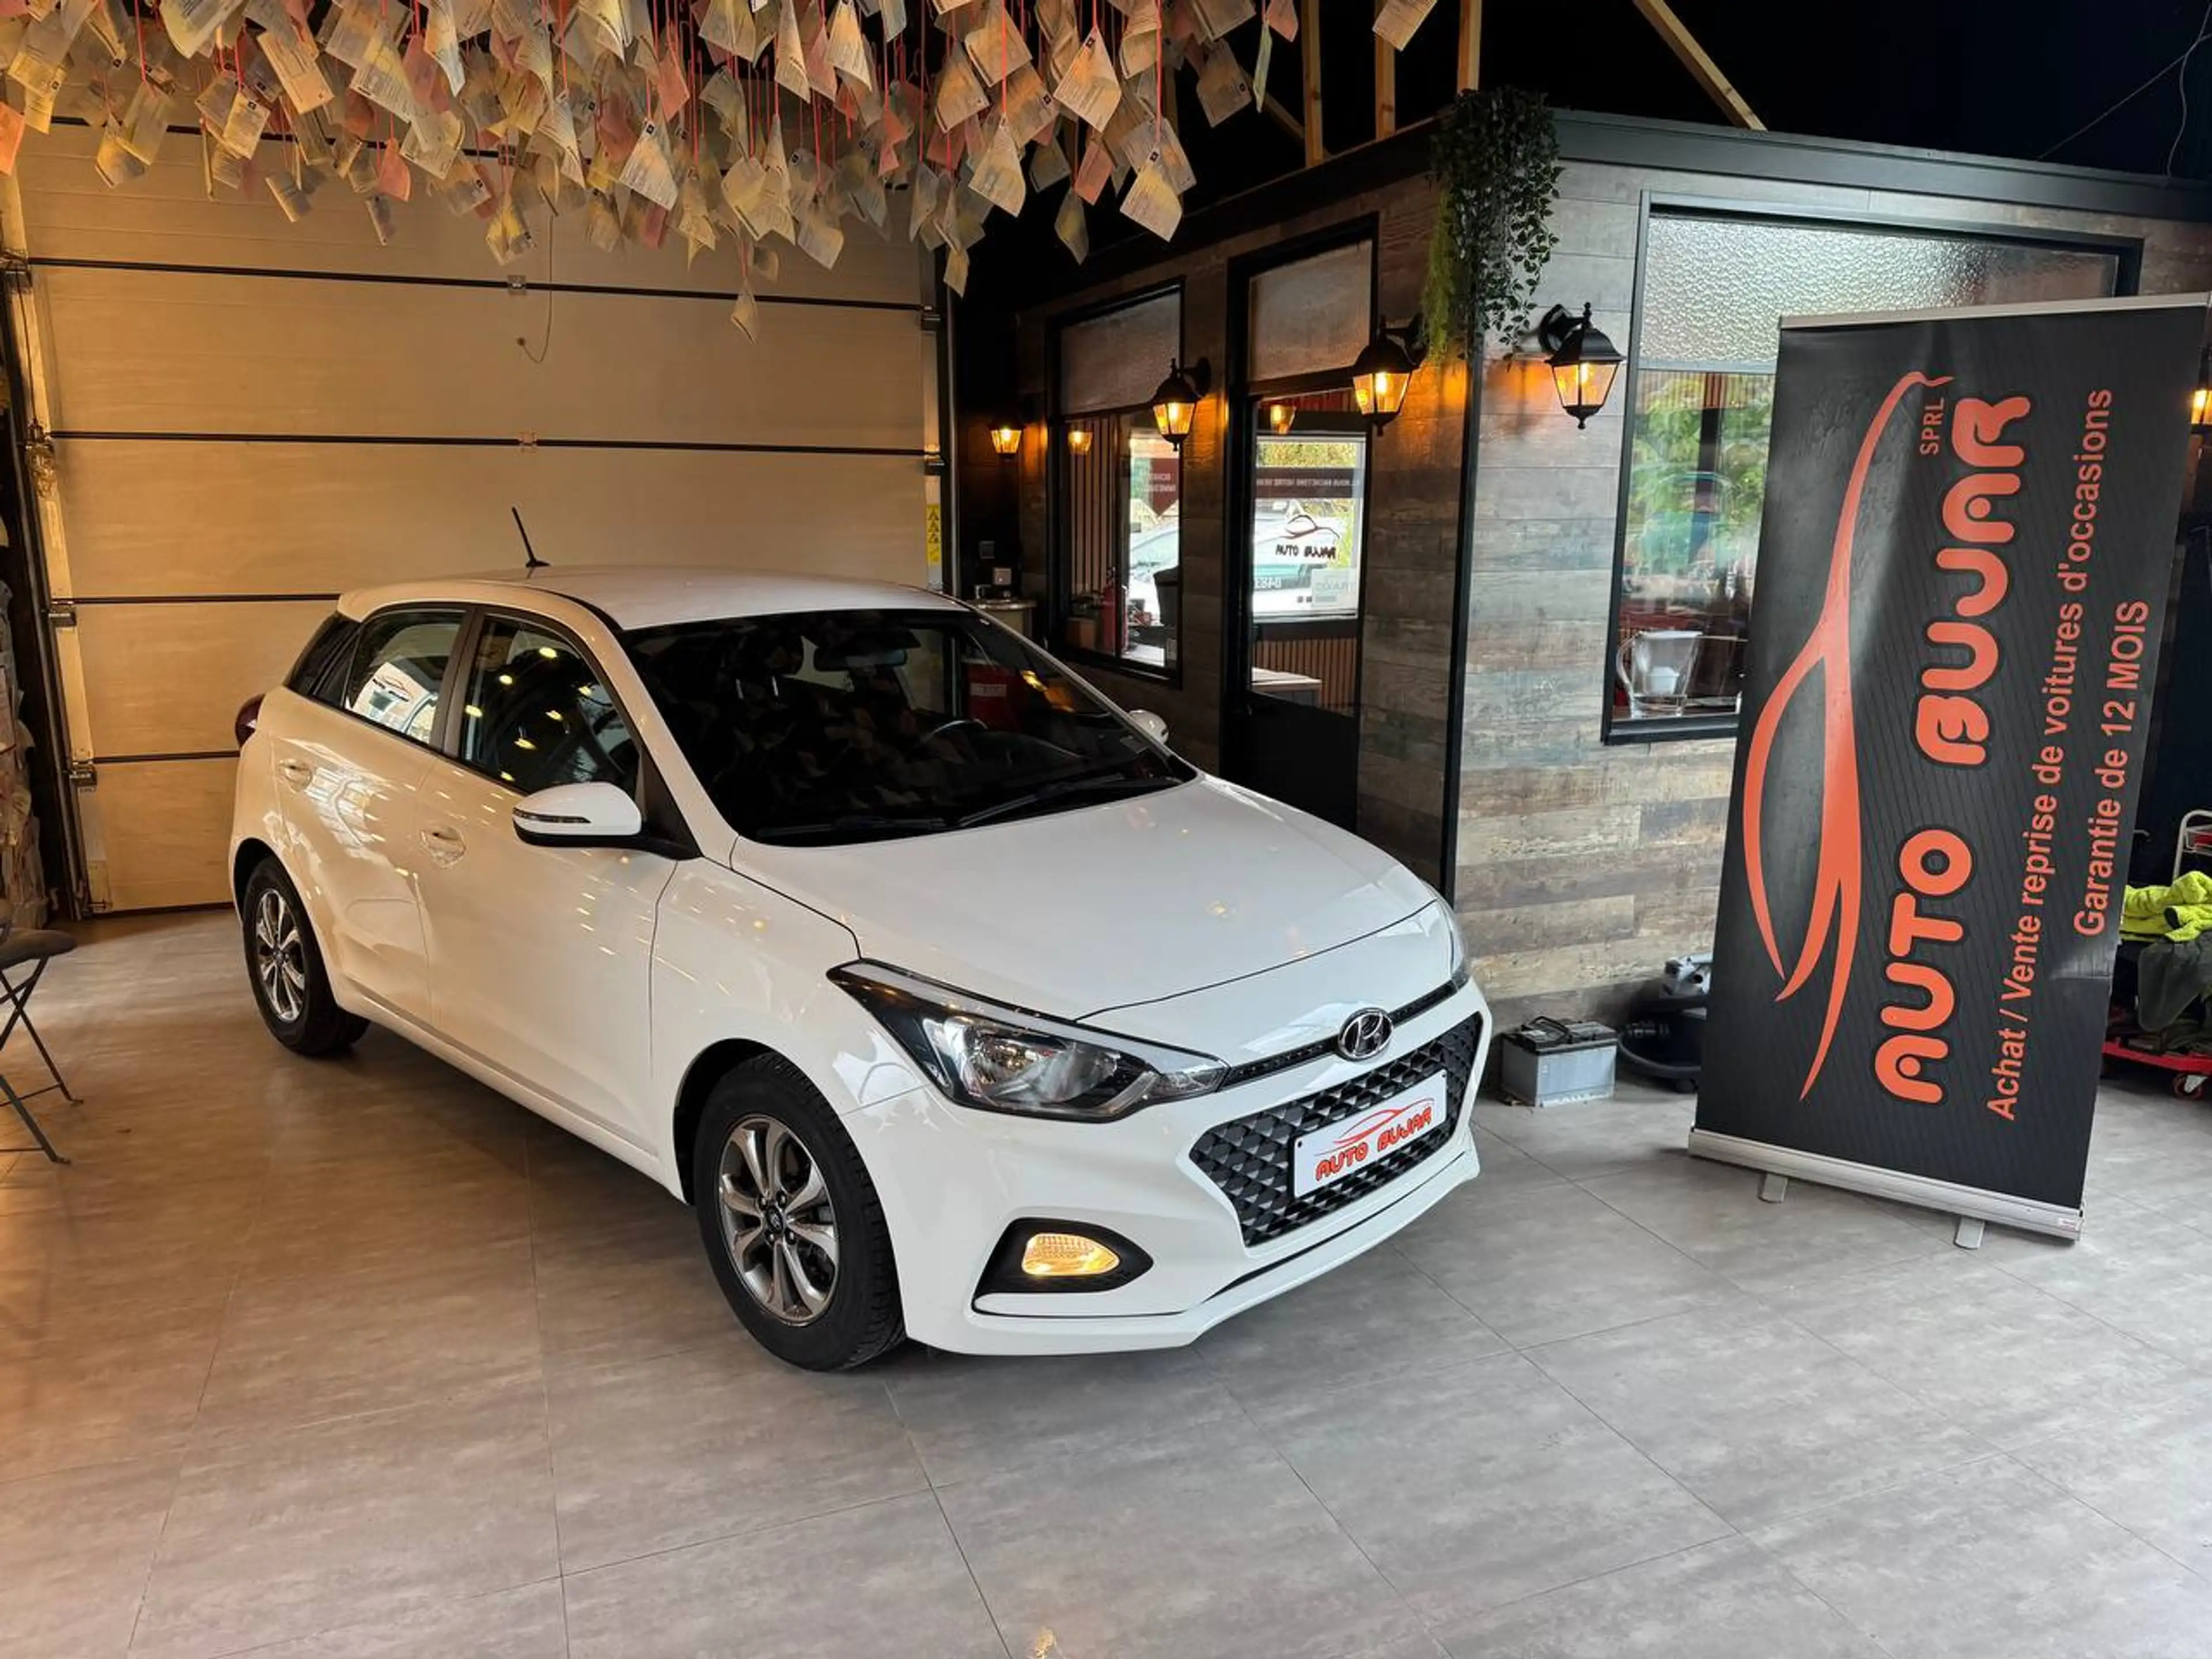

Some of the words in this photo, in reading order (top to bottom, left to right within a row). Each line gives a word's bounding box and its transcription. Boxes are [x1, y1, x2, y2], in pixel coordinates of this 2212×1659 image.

[1921, 398, 1945, 455] SPRL
[2056, 389, 2112, 593] d'occasions
[1275, 543, 1298, 557] AUTO
[1915, 396, 2031, 766] BUJAR
[2042, 603, 2084, 736] voitures
[2107, 600, 2150, 690] MOIS
[2101, 700, 2136, 737] 12
[2032, 745, 2064, 785] de
[2094, 749, 2128, 789] de
[2022, 794, 2058, 906] reprise
[2073, 798, 2121, 937] Garantie
[1875, 829, 1972, 1104] AUTO
[2001, 915, 2041, 1001] Vente
[1998, 1007, 2028, 1022] /
[1987, 1029, 2027, 1120] Achat
[1316, 1141, 1369, 1181] AUTO
[1377, 1106, 1433, 1152] BUJAR
